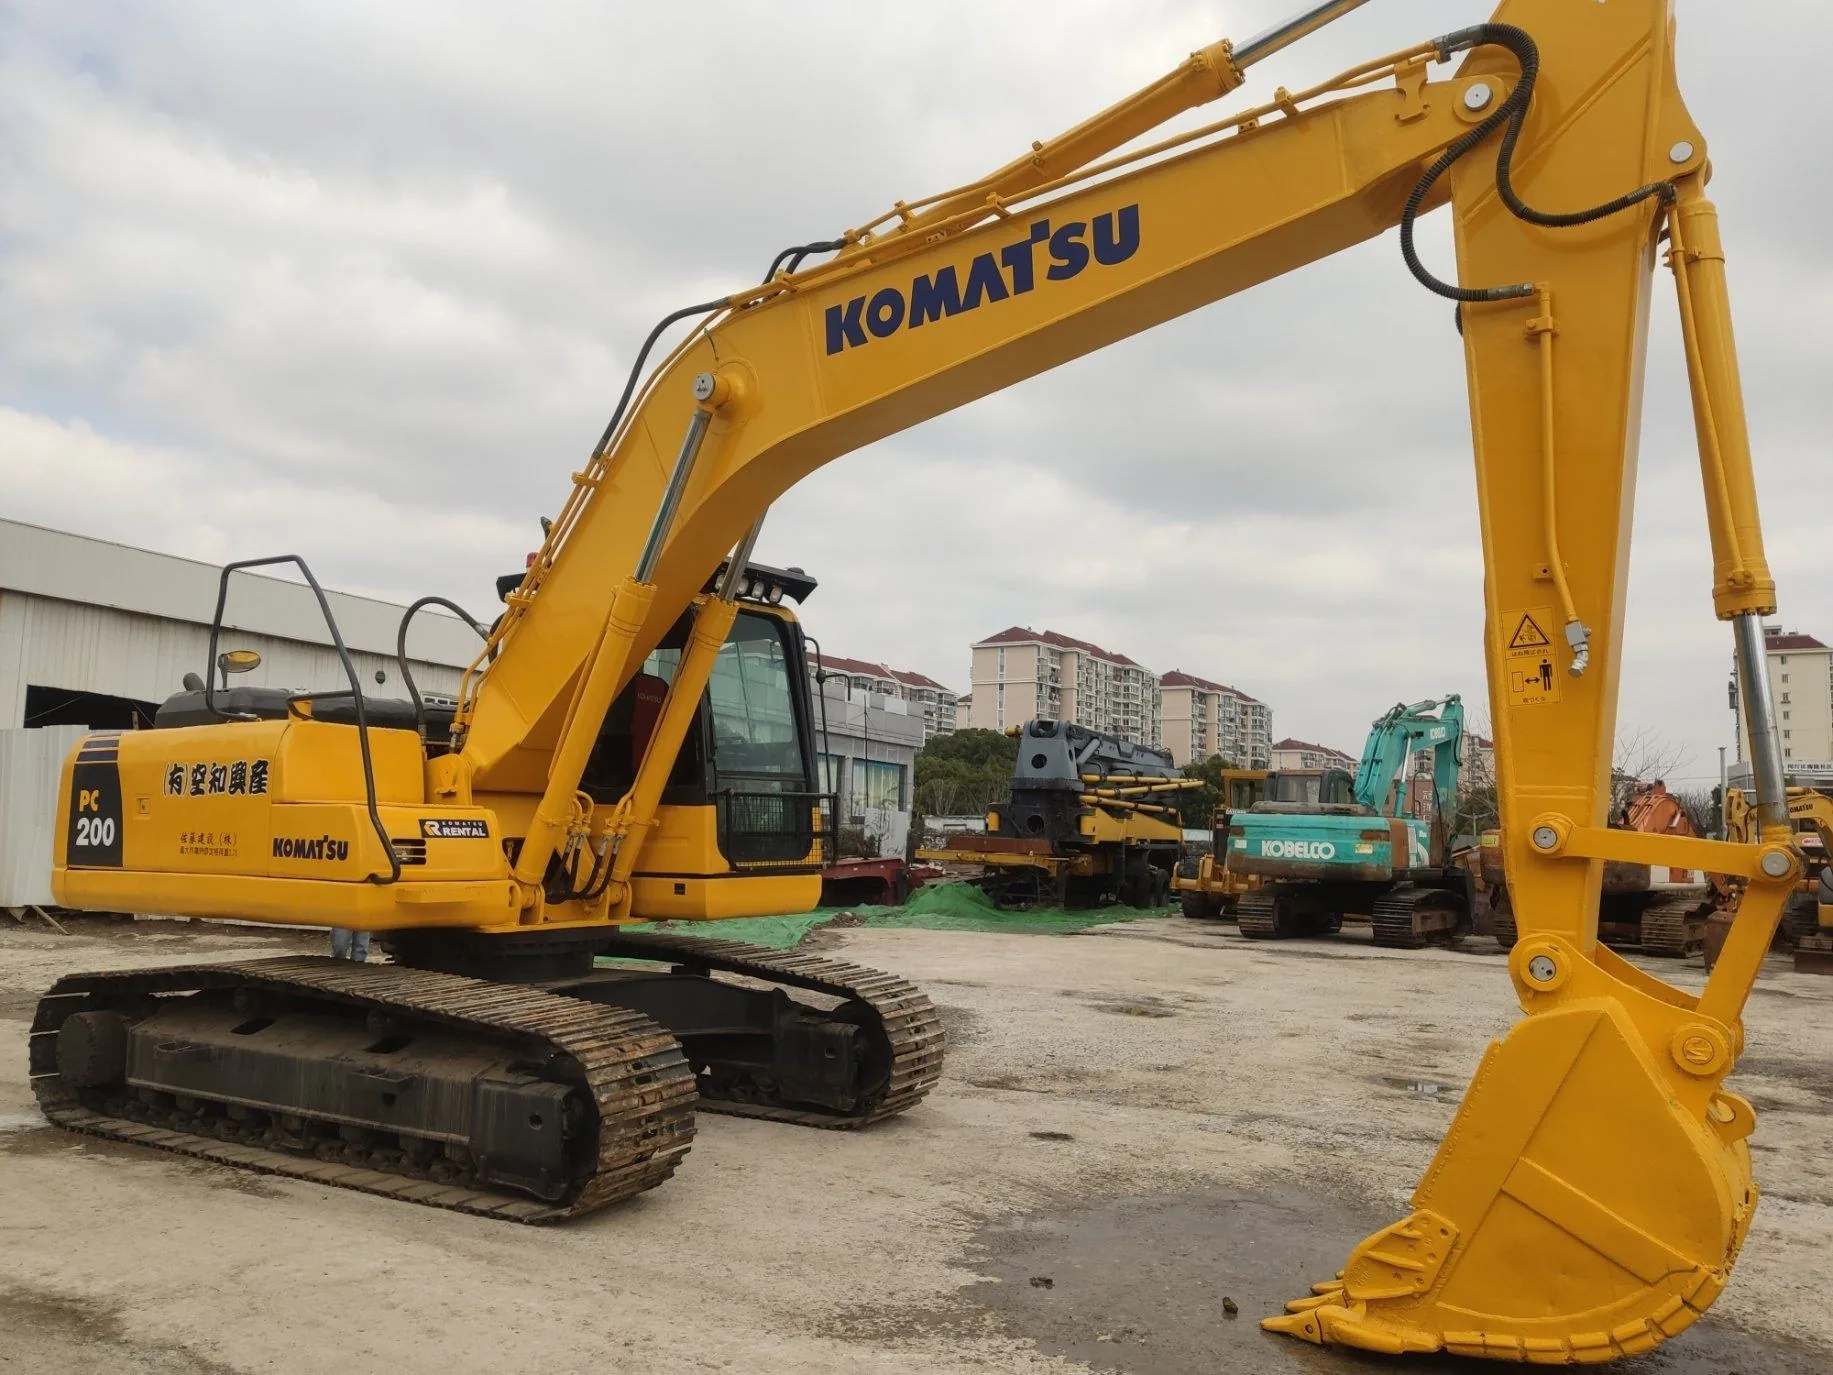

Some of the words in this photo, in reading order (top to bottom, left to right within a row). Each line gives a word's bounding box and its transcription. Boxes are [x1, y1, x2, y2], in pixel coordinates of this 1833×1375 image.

[825, 203, 1141, 357] KOMATSU
[79, 789, 100, 812] PC
[75, 817, 115, 847] 200
[442, 827, 487, 837] RENTAL
[272, 834, 349, 861] KOMATSU
[1261, 839, 1336, 860] KOBELCO
